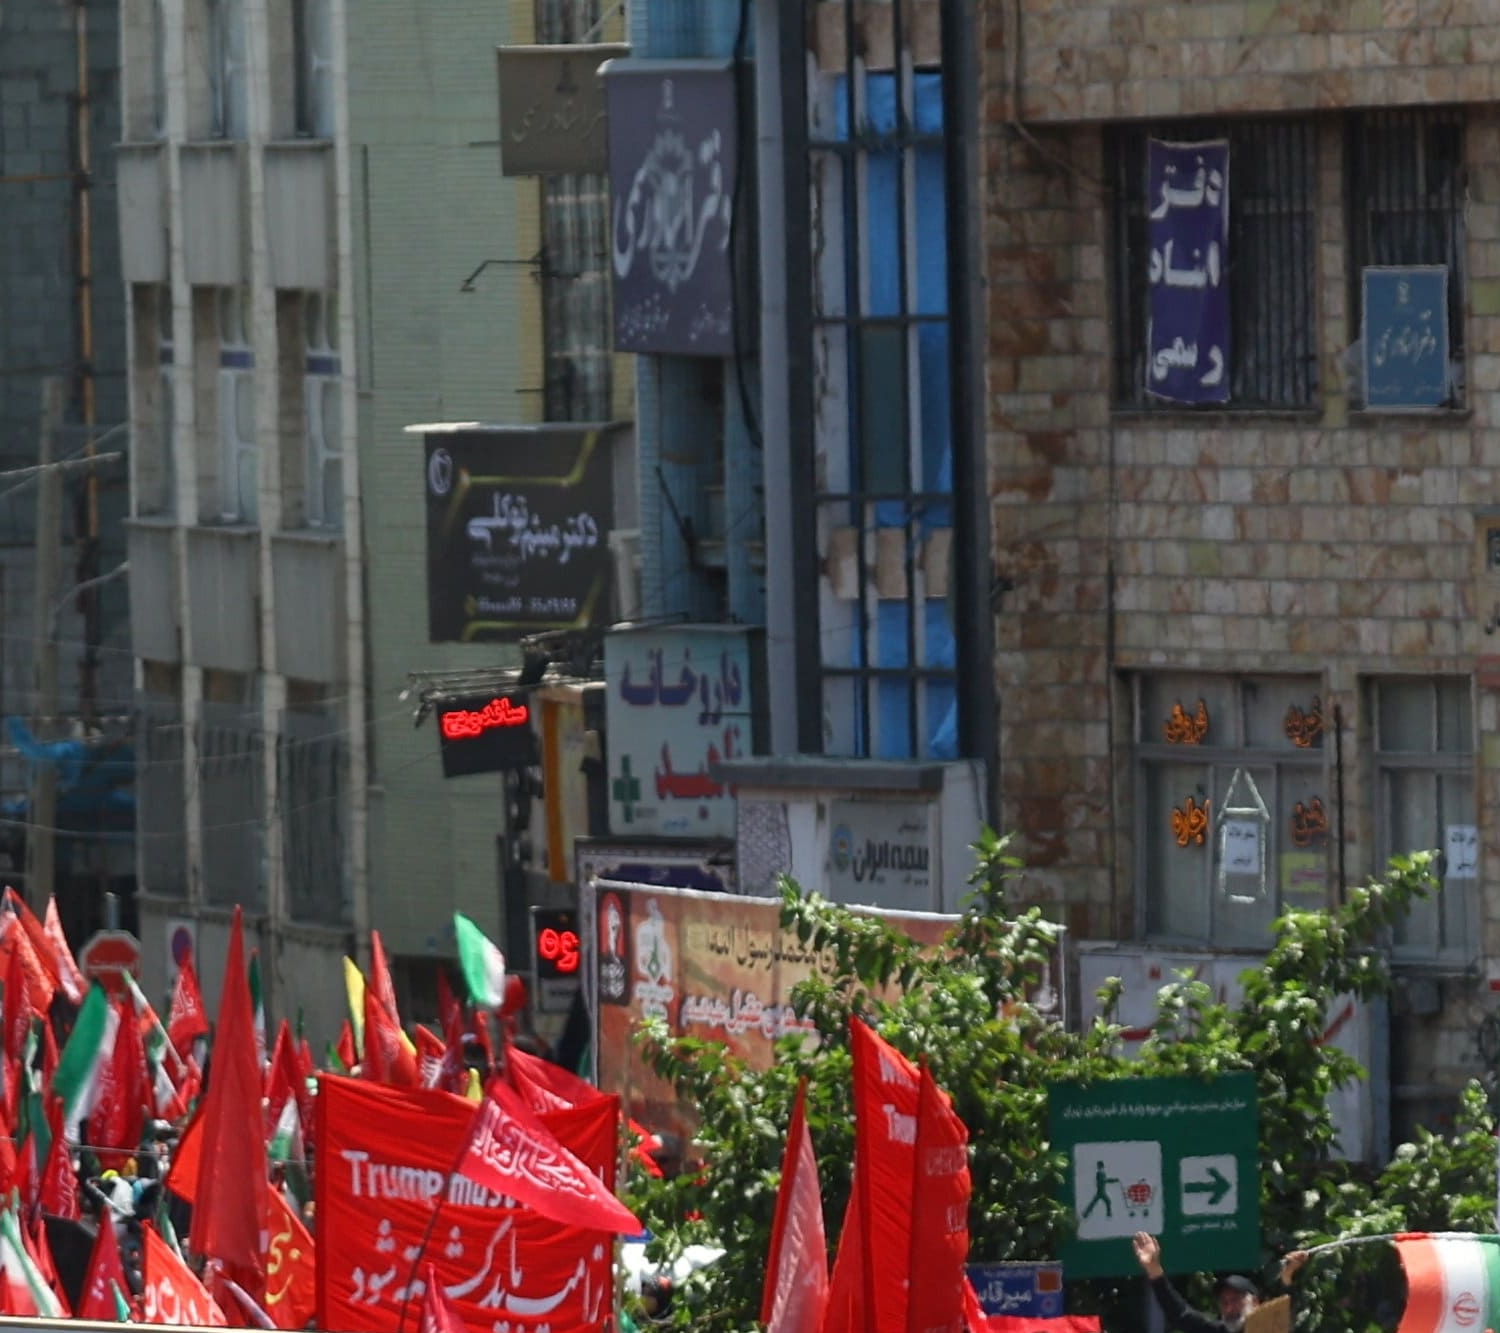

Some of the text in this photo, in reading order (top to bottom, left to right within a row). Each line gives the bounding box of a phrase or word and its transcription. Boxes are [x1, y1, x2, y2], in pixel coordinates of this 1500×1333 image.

[1150, 156, 1223, 219] دفتر
[1153, 336, 1224, 385] رسمی
[620, 648, 743, 726] داروخانه
[441, 696, 530, 739] ساندویچ
[341, 1149, 443, 1203] Trump
